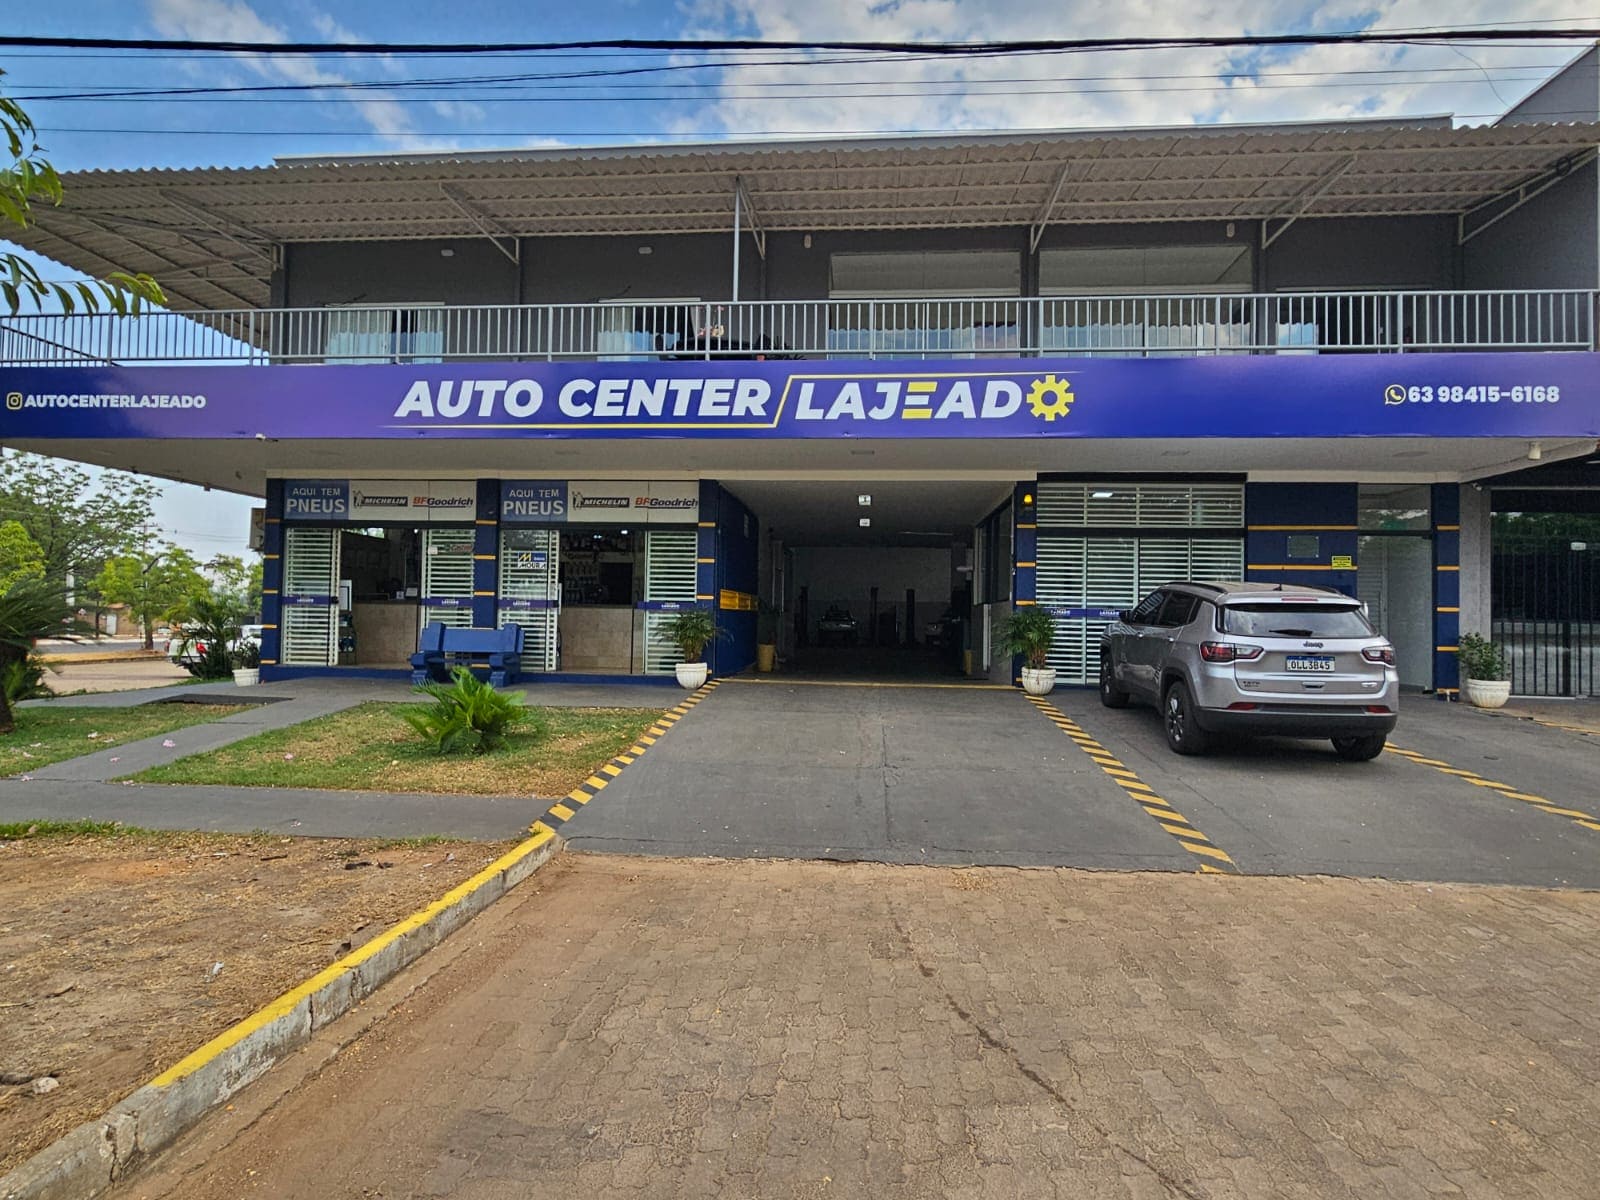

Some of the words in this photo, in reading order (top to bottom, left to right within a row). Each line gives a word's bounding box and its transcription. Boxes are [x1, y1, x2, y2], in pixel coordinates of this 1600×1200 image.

[24, 394, 207, 409] AUTOCENTERLAJEADO
[393, 379, 544, 418] AUTO
[558, 379, 772, 417] CENTER
[1408, 386, 1434, 403] 63
[1437, 385, 1560, 403] 98415-6168
[292, 487, 316, 496] AQUI
[321, 487, 341, 496] TEM
[509, 489, 534, 498] AQUI
[538, 488, 560, 498] TEM
[286, 498, 345, 513] PNEUS
[364, 497, 407, 505] MICHELIN
[503, 500, 564, 516] PNEUS
